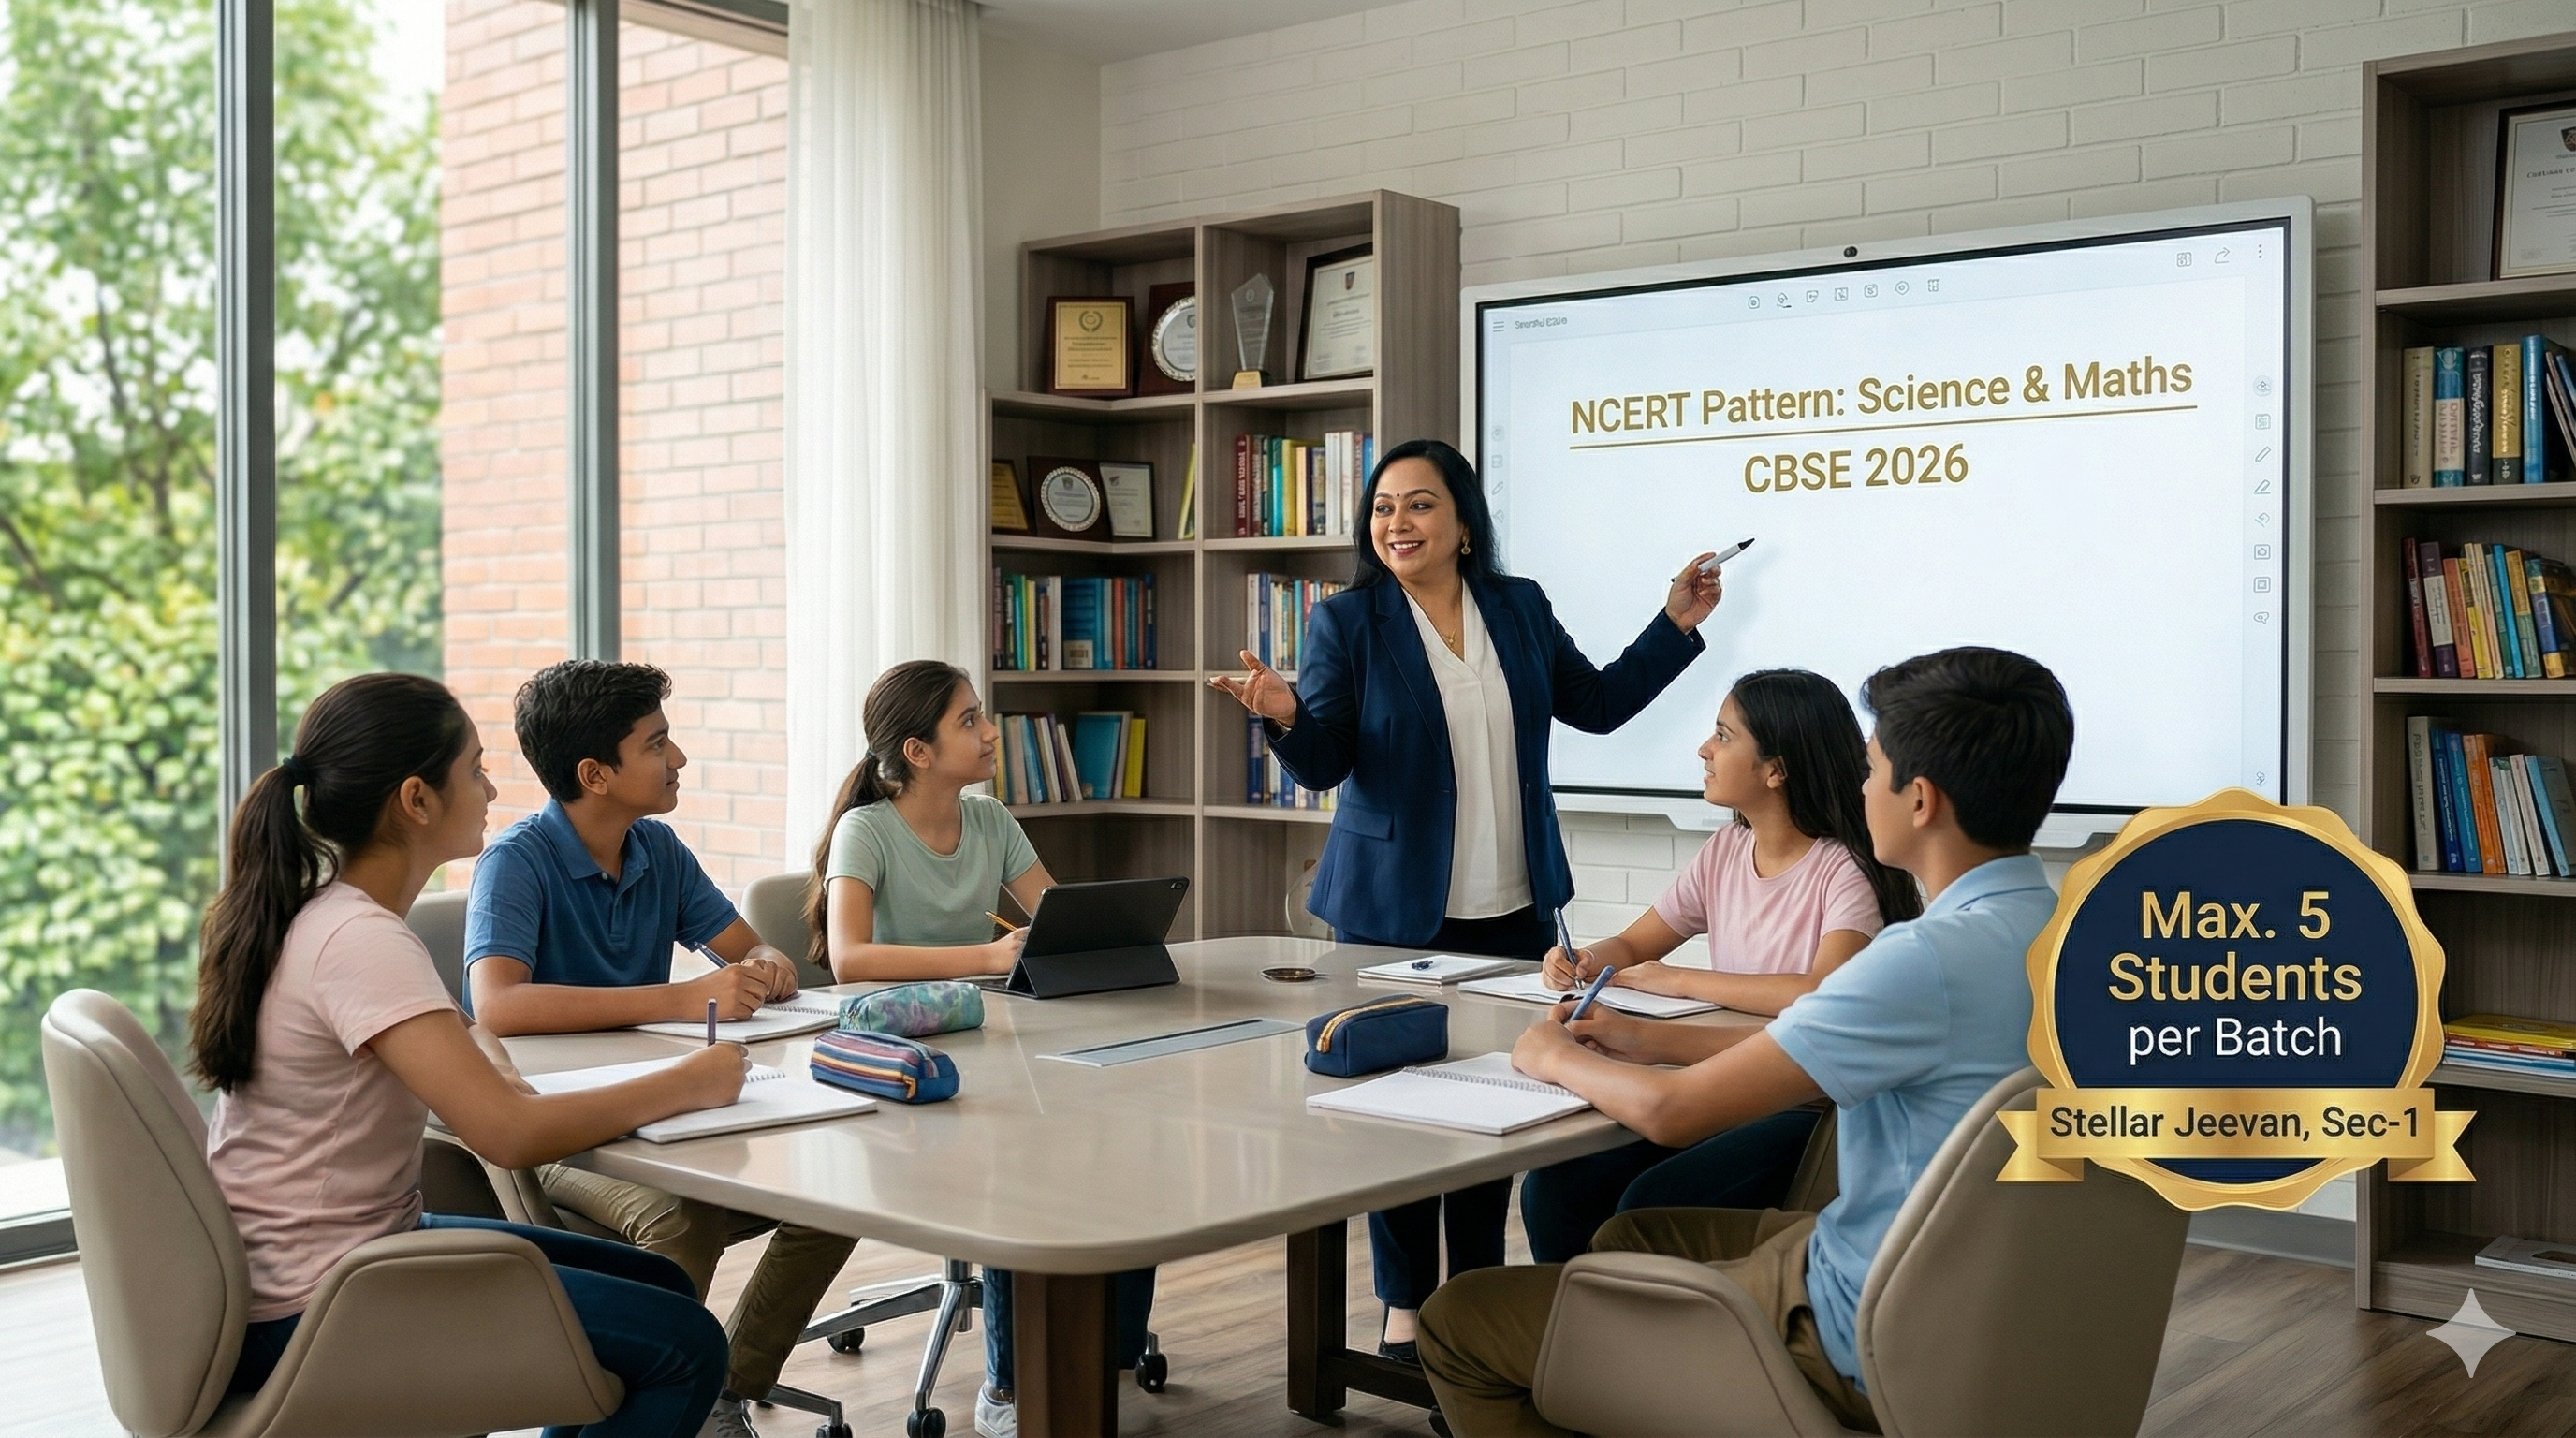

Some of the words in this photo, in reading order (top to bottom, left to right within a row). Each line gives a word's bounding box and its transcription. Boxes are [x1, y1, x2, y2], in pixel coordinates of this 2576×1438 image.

[1570, 390, 1692, 435] NCERT
[1701, 385, 1846, 427] Pattern:
[1856, 374, 2011, 415] Science
[2022, 364, 2052, 404] &
[2063, 354, 2193, 402] Maths
[1743, 449, 1852, 494] CBSE
[1864, 442, 1969, 489] 2026
